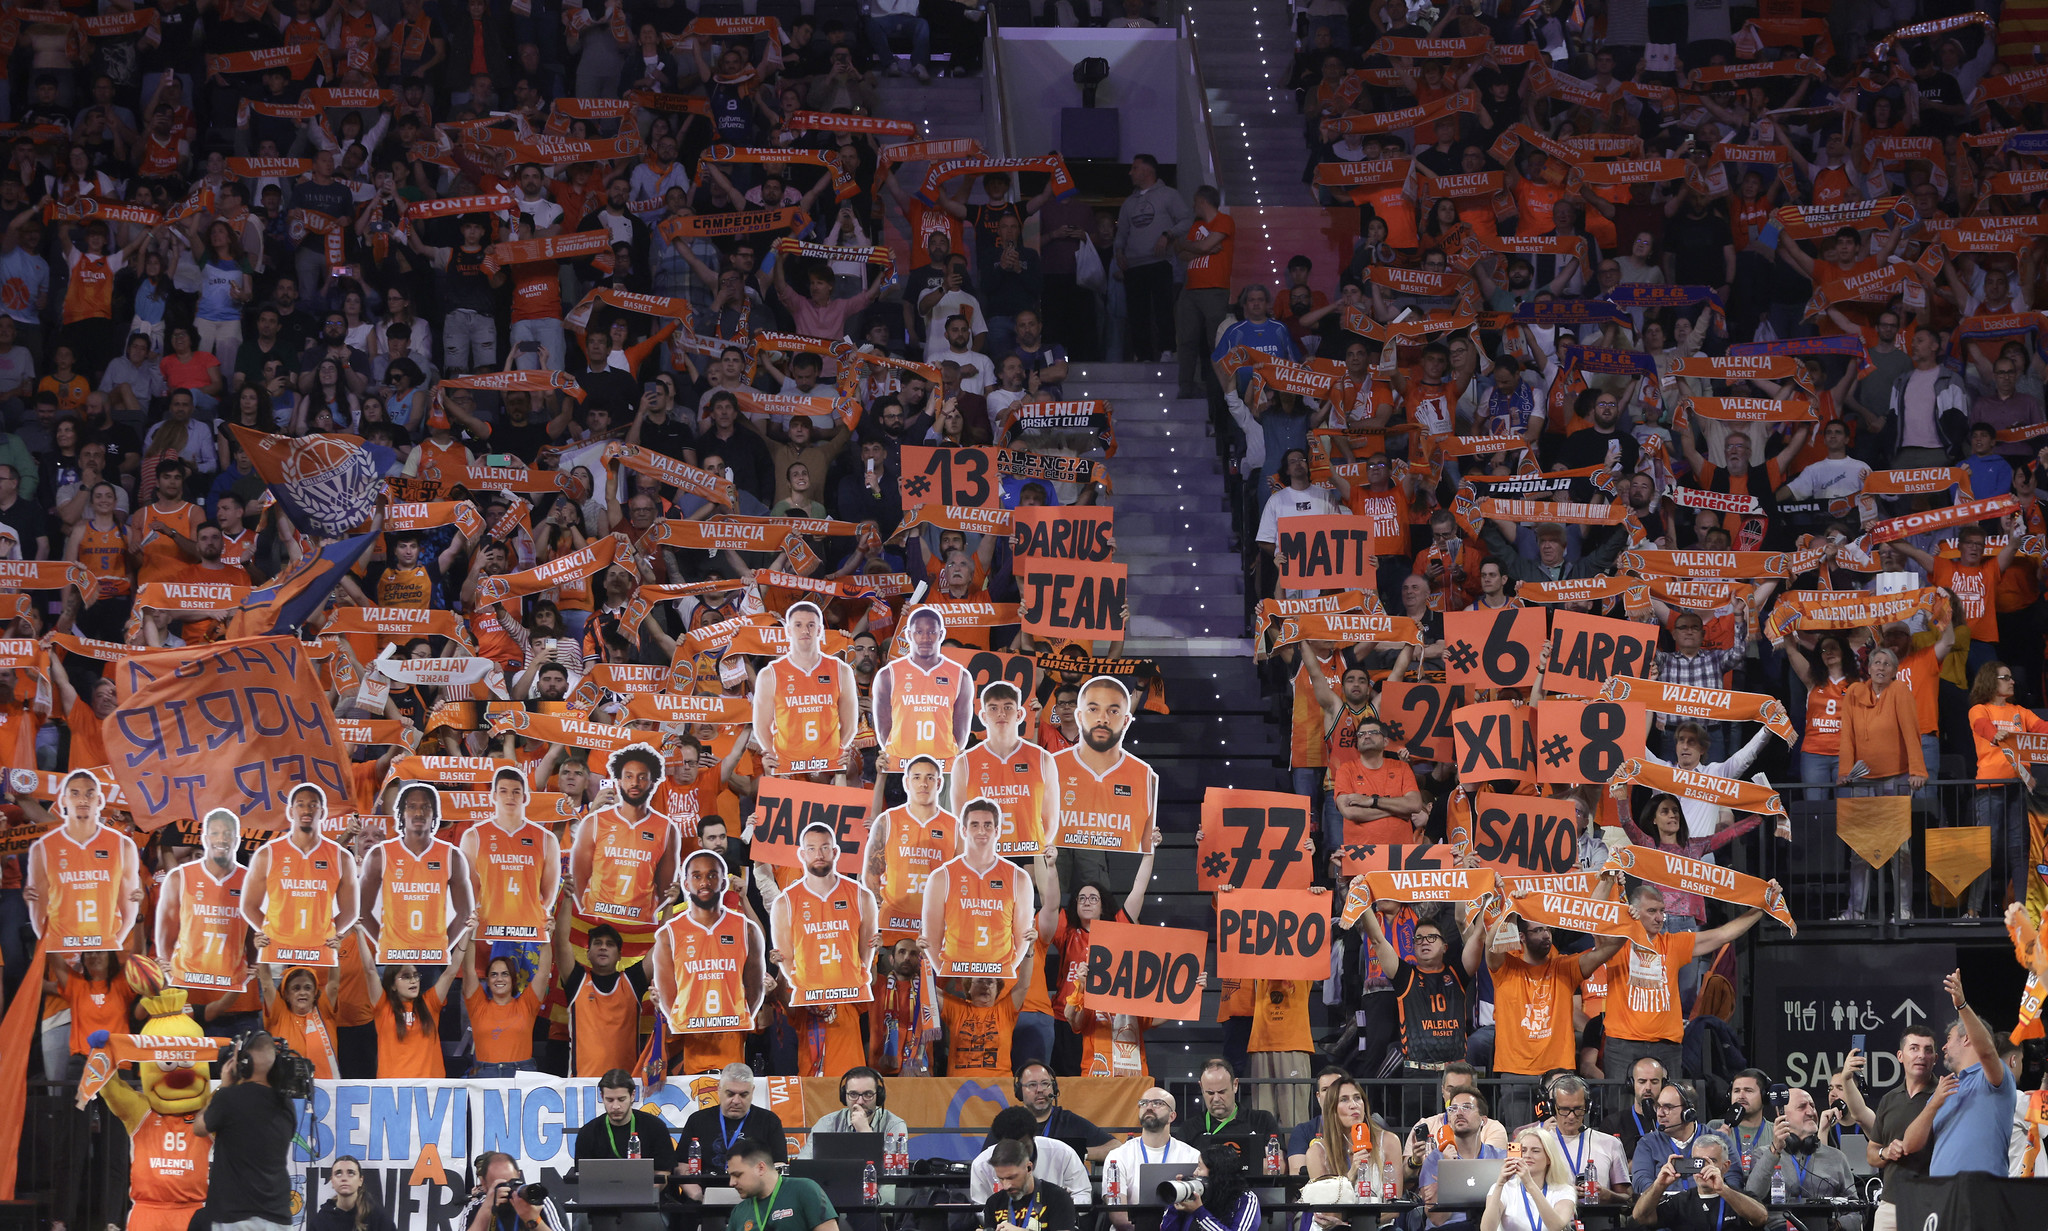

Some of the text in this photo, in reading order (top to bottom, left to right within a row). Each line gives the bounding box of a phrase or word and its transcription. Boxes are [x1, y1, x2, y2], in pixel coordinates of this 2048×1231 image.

[1415, 39, 1466, 50] VALENCIA
[577, 99, 630, 109] VALENCIA
[536, 142, 591, 155] VALENCIA
[247, 159, 299, 169] VALENCIA
[1607, 161, 1662, 173] VALENCIA
[1621, 174, 1648, 182] BASKET
[419, 196, 510, 213] FONTETA
[1798, 201, 1877, 215] VALENCIA
[693, 212, 781, 228] CAMPEONES
[1984, 317, 2021, 329] basket
[1711, 357, 1772, 370] VALENCIA
[1726, 370, 1756, 378] BASKET
[1014, 402, 1094, 419] VALENCIA
[1021, 416, 1089, 428] BASKET CLUB
[467, 466, 528, 482] VALENCIA
[904, 449, 989, 507] #13
[1890, 468, 1950, 482] VALENCIA
[481, 481, 513, 489] BASKET
[1904, 482, 1935, 492] BASKET
[945, 507, 1009, 527] VALENCIA
[1892, 501, 2000, 531] FONTETA
[699, 523, 764, 540] VALENCIA
[960, 522, 993, 532] BASKET
[714, 540, 747, 549] BASKET
[1014, 519, 1110, 560] DARIUS
[1281, 530, 1367, 577] MATT
[1671, 553, 1736, 568] VALENCIA
[534, 551, 596, 581] VALENCIA
[1688, 569, 1720, 577] BASKET
[553, 569, 583, 585] BASKET
[1541, 575, 1607, 591] VALENCIA
[163, 584, 232, 600] VALENCIA
[1558, 590, 1590, 599] BASKET
[1665, 583, 1729, 598] VALENCIA
[1028, 573, 1125, 630] JEAN
[1278, 601, 1340, 615] VALENCIA
[1680, 598, 1713, 607] BASKET
[1810, 597, 1914, 620] VALENCIA BASKET
[363, 608, 429, 622] VALENCIA
[378, 624, 412, 632] BASKET
[1324, 616, 1392, 632] VALENCIA
[1342, 632, 1375, 640] BASKET
[1448, 609, 1529, 685] #6
[1040, 658, 1135, 673] BASKET CLUB
[625, 683, 657, 691] BASKET
[654, 696, 725, 712] VALENCIA
[785, 696, 833, 706] VALENCIA
[901, 696, 948, 707] VALENCIA
[1662, 685, 1731, 709] VALENCIA
[671, 712, 707, 721] BASKET
[1675, 705, 1711, 716] BASKET
[561, 719, 632, 740] VALENCIA
[805, 721, 818, 741] 6
[916, 721, 934, 741] 10
[576, 738, 612, 748] BASKET
[1540, 703, 1626, 782] #8
[421, 757, 494, 771] VALENCIA
[791, 758, 827, 771] XABI LÓPEZ
[440, 772, 476, 780] BASKET
[1673, 769, 1739, 798] VALENCIA
[981, 785, 1030, 797] VALENCIA
[1684, 788, 1720, 803] BASKET
[755, 796, 866, 853] JAIME
[1060, 810, 1131, 831] VALENCIA
[1004, 841, 1039, 851] DE LARREA
[1202, 808, 1305, 888] #77
[1475, 809, 1576, 873] SAKO
[489, 854, 534, 866] VALENCIA
[604, 847, 651, 861] VALENCIA
[899, 847, 942, 860] VALENCIA
[58, 870, 110, 882] VALENCIA
[1665, 855, 1734, 890] VALENCIA
[281, 879, 327, 891] VALENCIA
[392, 882, 440, 894] VALENCIA
[507, 877, 519, 894] 4
[620, 875, 632, 894] 7
[1391, 873, 1469, 889] VALENCIA
[1514, 876, 1589, 893] VALENCIA
[1681, 879, 1716, 895] BASKET
[1412, 890, 1449, 899] BASKET
[76, 900, 97, 923] 12
[193, 905, 241, 918] VALENCIA
[595, 903, 641, 917] BRAXTON KEY
[961, 898, 1003, 911] VALENCIA
[1542, 896, 1619, 923] VALENCIA
[300, 910, 306, 929] 1
[410, 911, 422, 931] 0
[803, 920, 849, 931] VALENCIA
[889, 918, 905, 928] ISAAC
[1559, 917, 1598, 931] BASKET
[485, 926, 537, 937] JAIME PRADILLA
[977, 927, 989, 947] 3
[1219, 909, 1325, 957] PEDRO
[63, 936, 101, 946] NEAL SAKO
[203, 931, 228, 954] 77
[277, 951, 319, 961] KAM TAYLOR
[417, 950, 442, 960] BADIO
[819, 945, 842, 964] 24
[684, 959, 736, 972] VALENCIA
[952, 962, 1001, 973] NATE REUVERS
[185, 973, 231, 986] YANKUBA SIMA
[698, 972, 725, 980] BASKET
[1085, 945, 1200, 1004] BADIO
[805, 988, 858, 999] MATT COSTELLO
[706, 990, 720, 1013] 8
[688, 1016, 739, 1028] JEAN MONTERO
[128, 1035, 216, 1048] VALENCIA
[155, 1050, 196, 1060] BASKET
[165, 1132, 185, 1150] 86
[150, 1159, 193, 1171] VALENCIA
